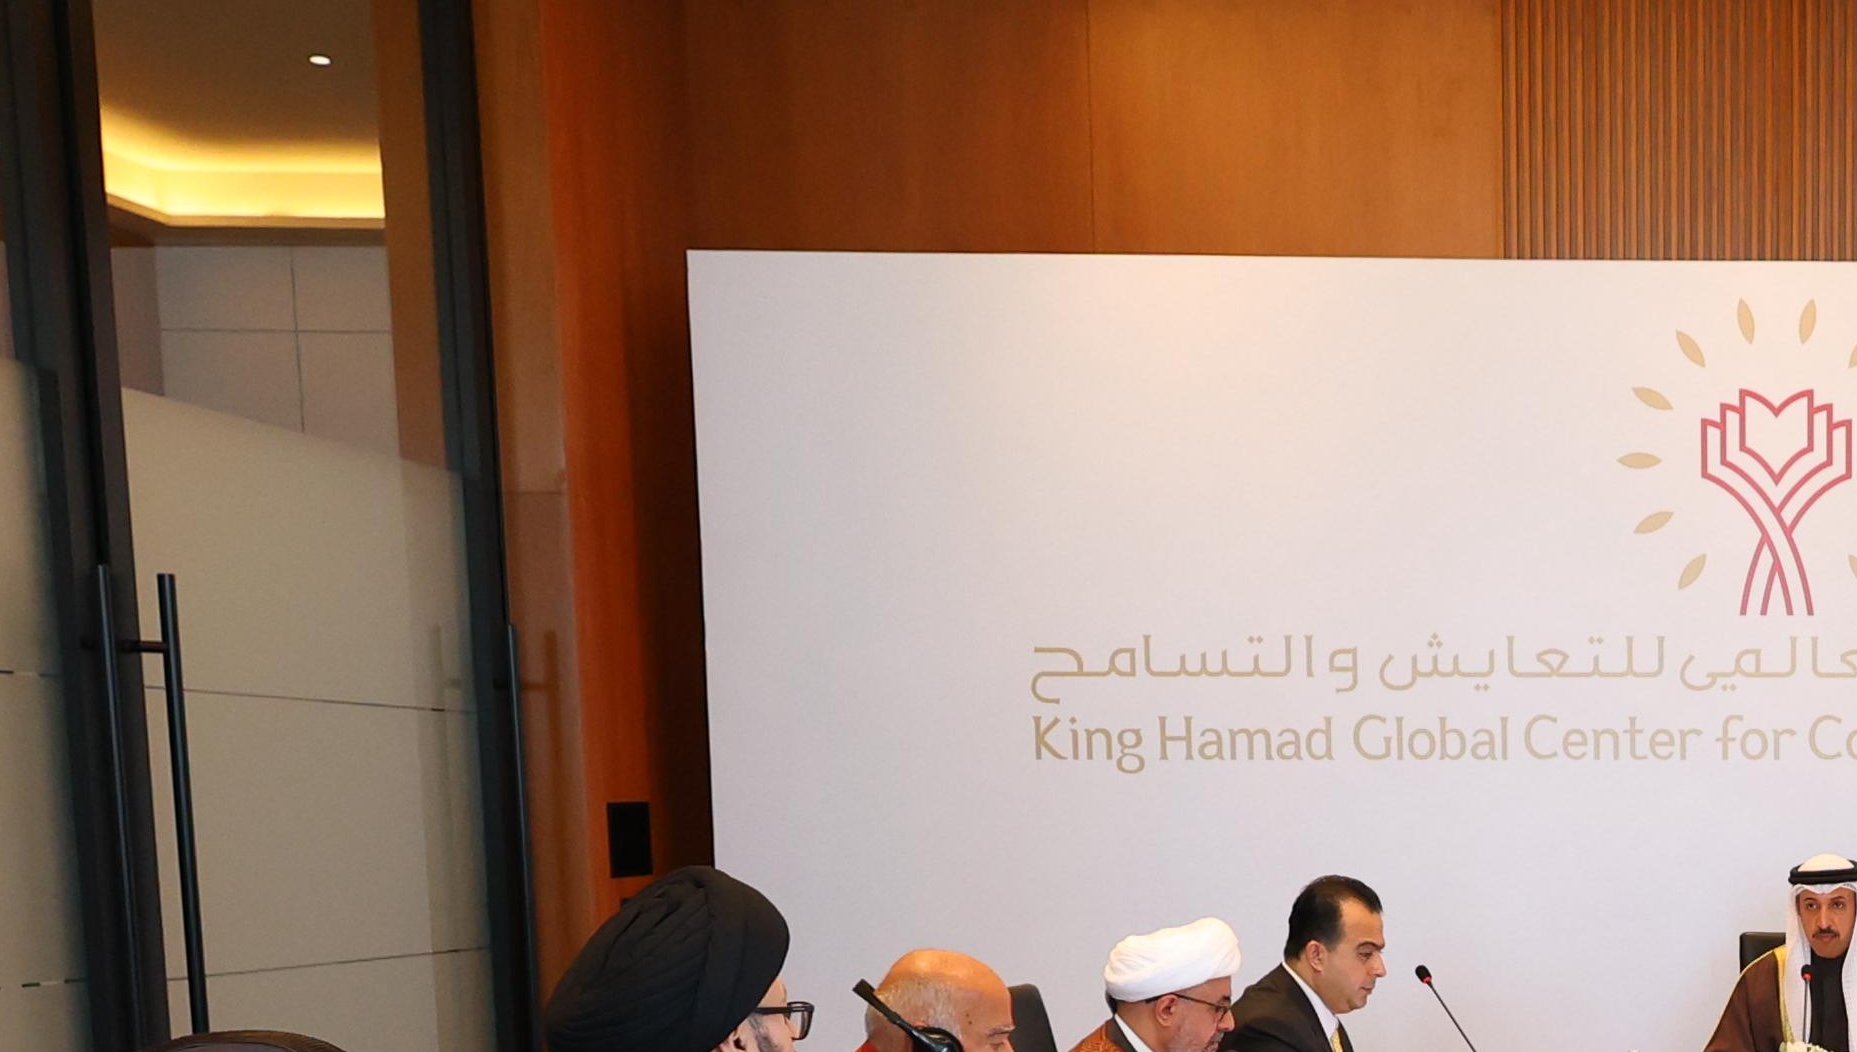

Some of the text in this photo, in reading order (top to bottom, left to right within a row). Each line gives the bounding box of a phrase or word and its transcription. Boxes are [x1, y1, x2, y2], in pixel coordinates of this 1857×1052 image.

[1378, 632, 1667, 693] للتعايش
[1031, 715, 1147, 775] King
[1157, 715, 1337, 762] Hamad
[1352, 714, 1510, 762] Global
[1523, 714, 1703, 762] Center
[1715, 714, 1798, 762] for
